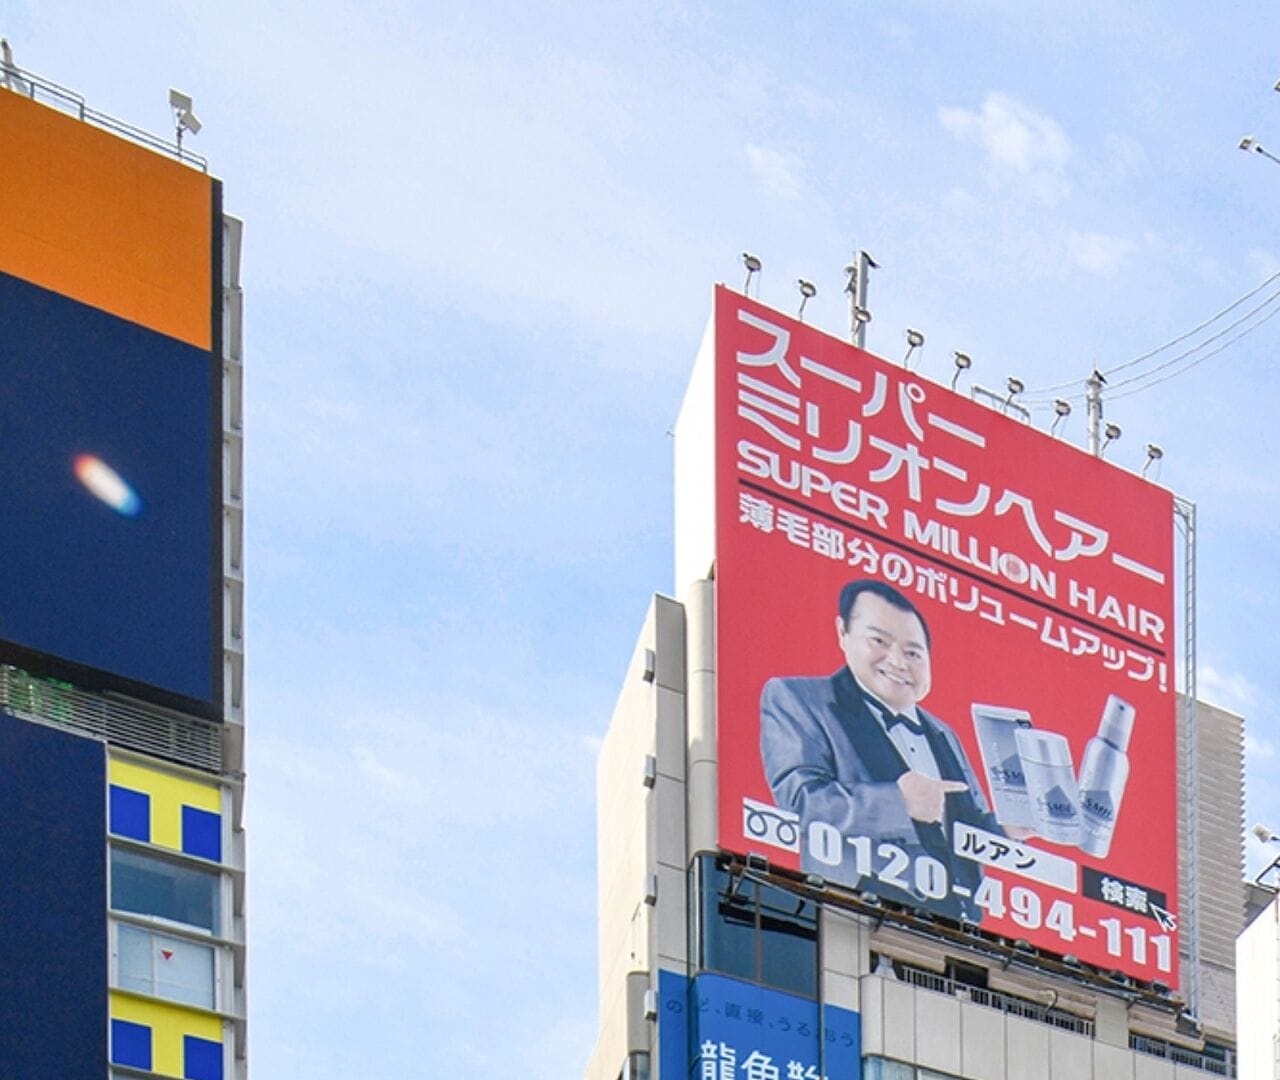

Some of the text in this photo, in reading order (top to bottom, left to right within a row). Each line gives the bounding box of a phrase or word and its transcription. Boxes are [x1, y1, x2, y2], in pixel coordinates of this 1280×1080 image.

[736, 308, 986, 449] スーパー
[736, 371, 1165, 585] ミリオンヘアー
[736, 440, 1167, 642] SUPER MILLION HAIR
[807, 821, 1173, 975] 0120-494-111
[960, 831, 1037, 869] ルアン
